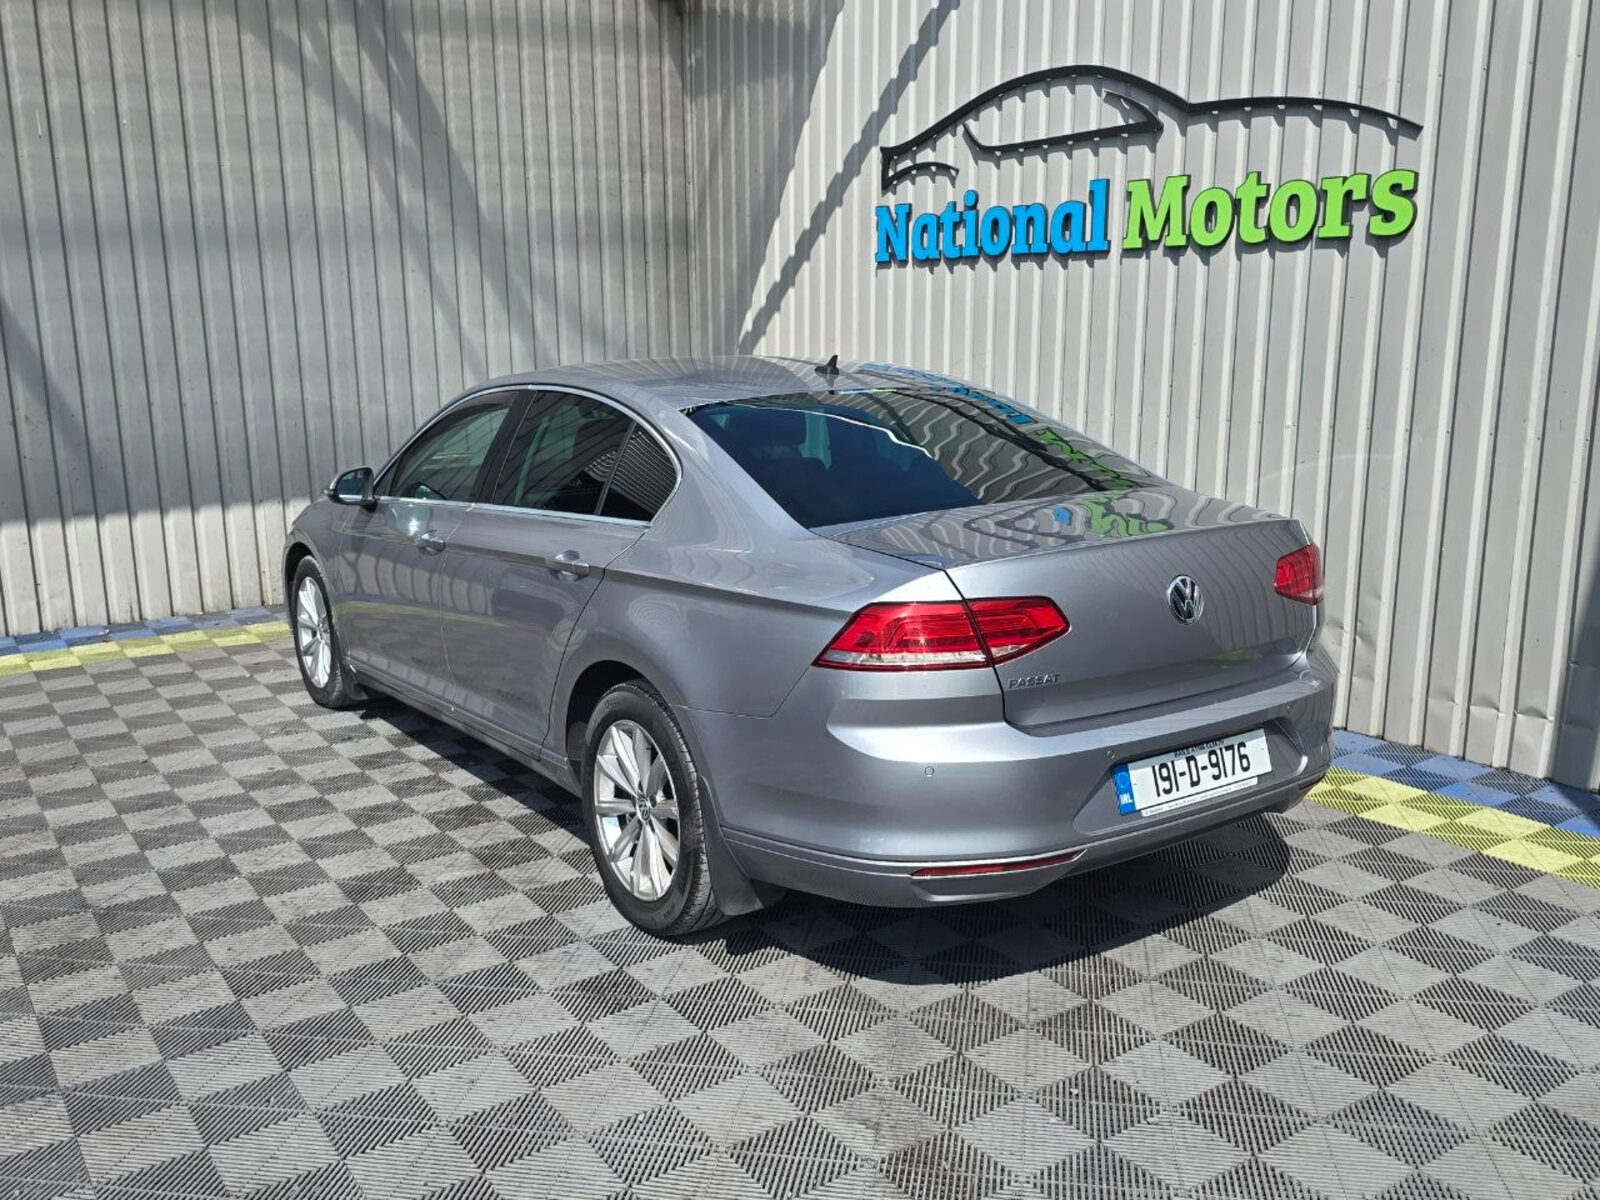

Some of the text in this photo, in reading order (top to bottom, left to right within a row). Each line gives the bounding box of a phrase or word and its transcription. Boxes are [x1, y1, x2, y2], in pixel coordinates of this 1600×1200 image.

[875, 168, 1419, 263] National Motors
[1009, 674, 1061, 689] PASSAT
[1152, 741, 1251, 797] 191-D-9176
[1119, 793, 1133, 804] IRL
